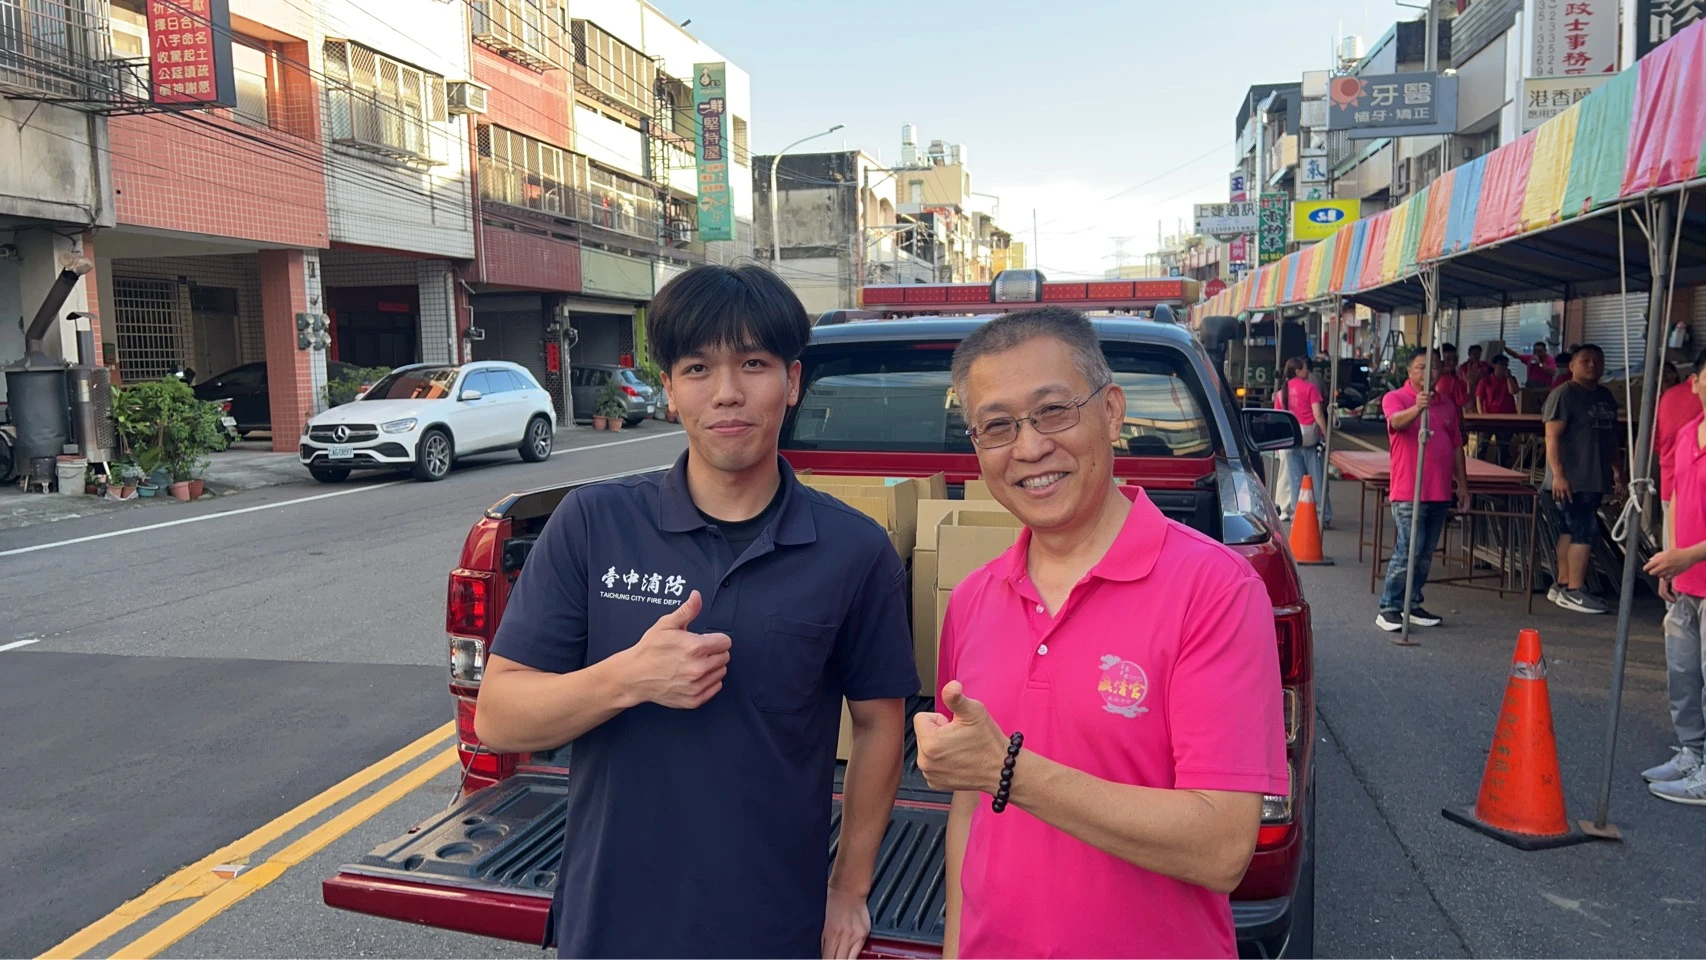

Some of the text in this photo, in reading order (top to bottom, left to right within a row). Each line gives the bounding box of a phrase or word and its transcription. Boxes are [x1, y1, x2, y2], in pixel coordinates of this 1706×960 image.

[156, 31, 207, 48] 八字命名
[1562, 2, 1594, 75] 政士事務
[157, 48, 208, 64] 收驚起土
[1370, 82, 1432, 107] 牙醫
[1306, 159, 1326, 180] 氣
[601, 565, 687, 597] 臺中消防
[600, 590, 630, 601] TAICHUNG
[630, 594, 646, 603] CITY
[646, 597, 662, 605] FIRE
